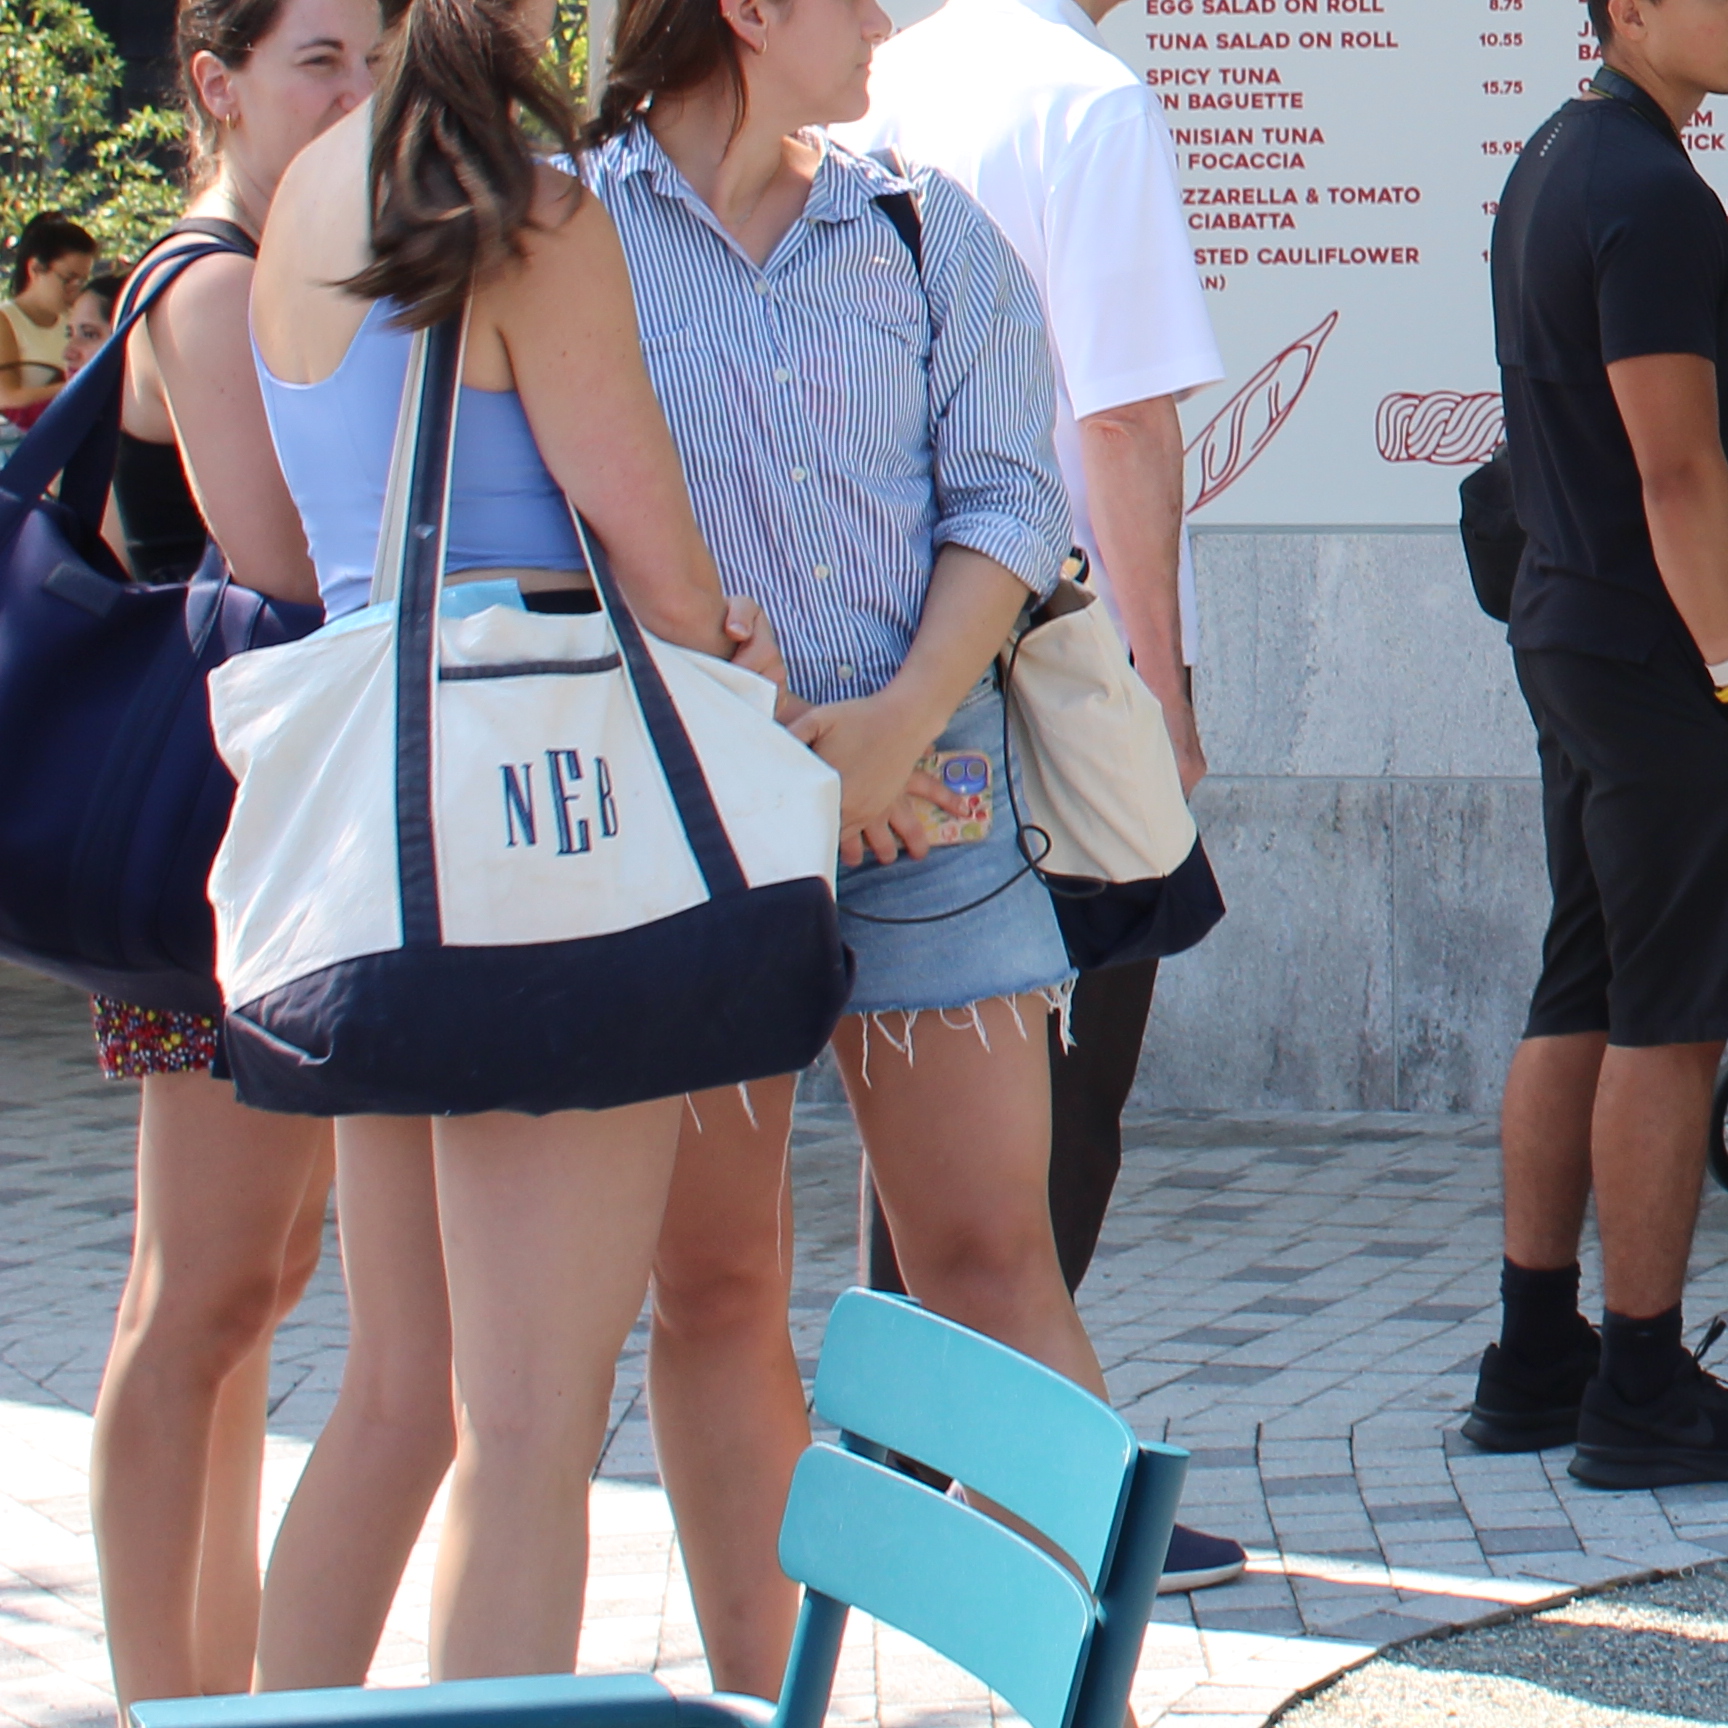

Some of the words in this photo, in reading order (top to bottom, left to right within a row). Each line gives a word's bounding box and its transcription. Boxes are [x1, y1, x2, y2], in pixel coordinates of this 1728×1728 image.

[1146, 33, 1209, 51] TUNA
[1216, 32, 1291, 50] SALAD
[1298, 31, 1332, 49] ON
[1341, 31, 1399, 49] ROLL
[1479, 32, 1523, 47] 10.55
[1146, 68, 1211, 86] SPICY
[1218, 67, 1281, 85] TUNA
[1482, 80, 1523, 95] 15.75
[1188, 92, 1303, 110] BAGUETTE
[1176, 128, 1253, 146] NISIAN
[1261, 127, 1325, 145] TUNA
[1480, 140, 1523, 156] 15.95
[1188, 152, 1305, 170] FOCACCIA
[1182, 187, 1298, 206] ZZARELLA
[1305, 187, 1319, 205] &
[1327, 186, 1421, 204] TOMATO
[1187, 212, 1296, 230] CIABATTA
[1193, 248, 1249, 265] STED
[1256, 247, 1419, 265] CAULIFLOWER
[499, 748, 619, 856] NEB
